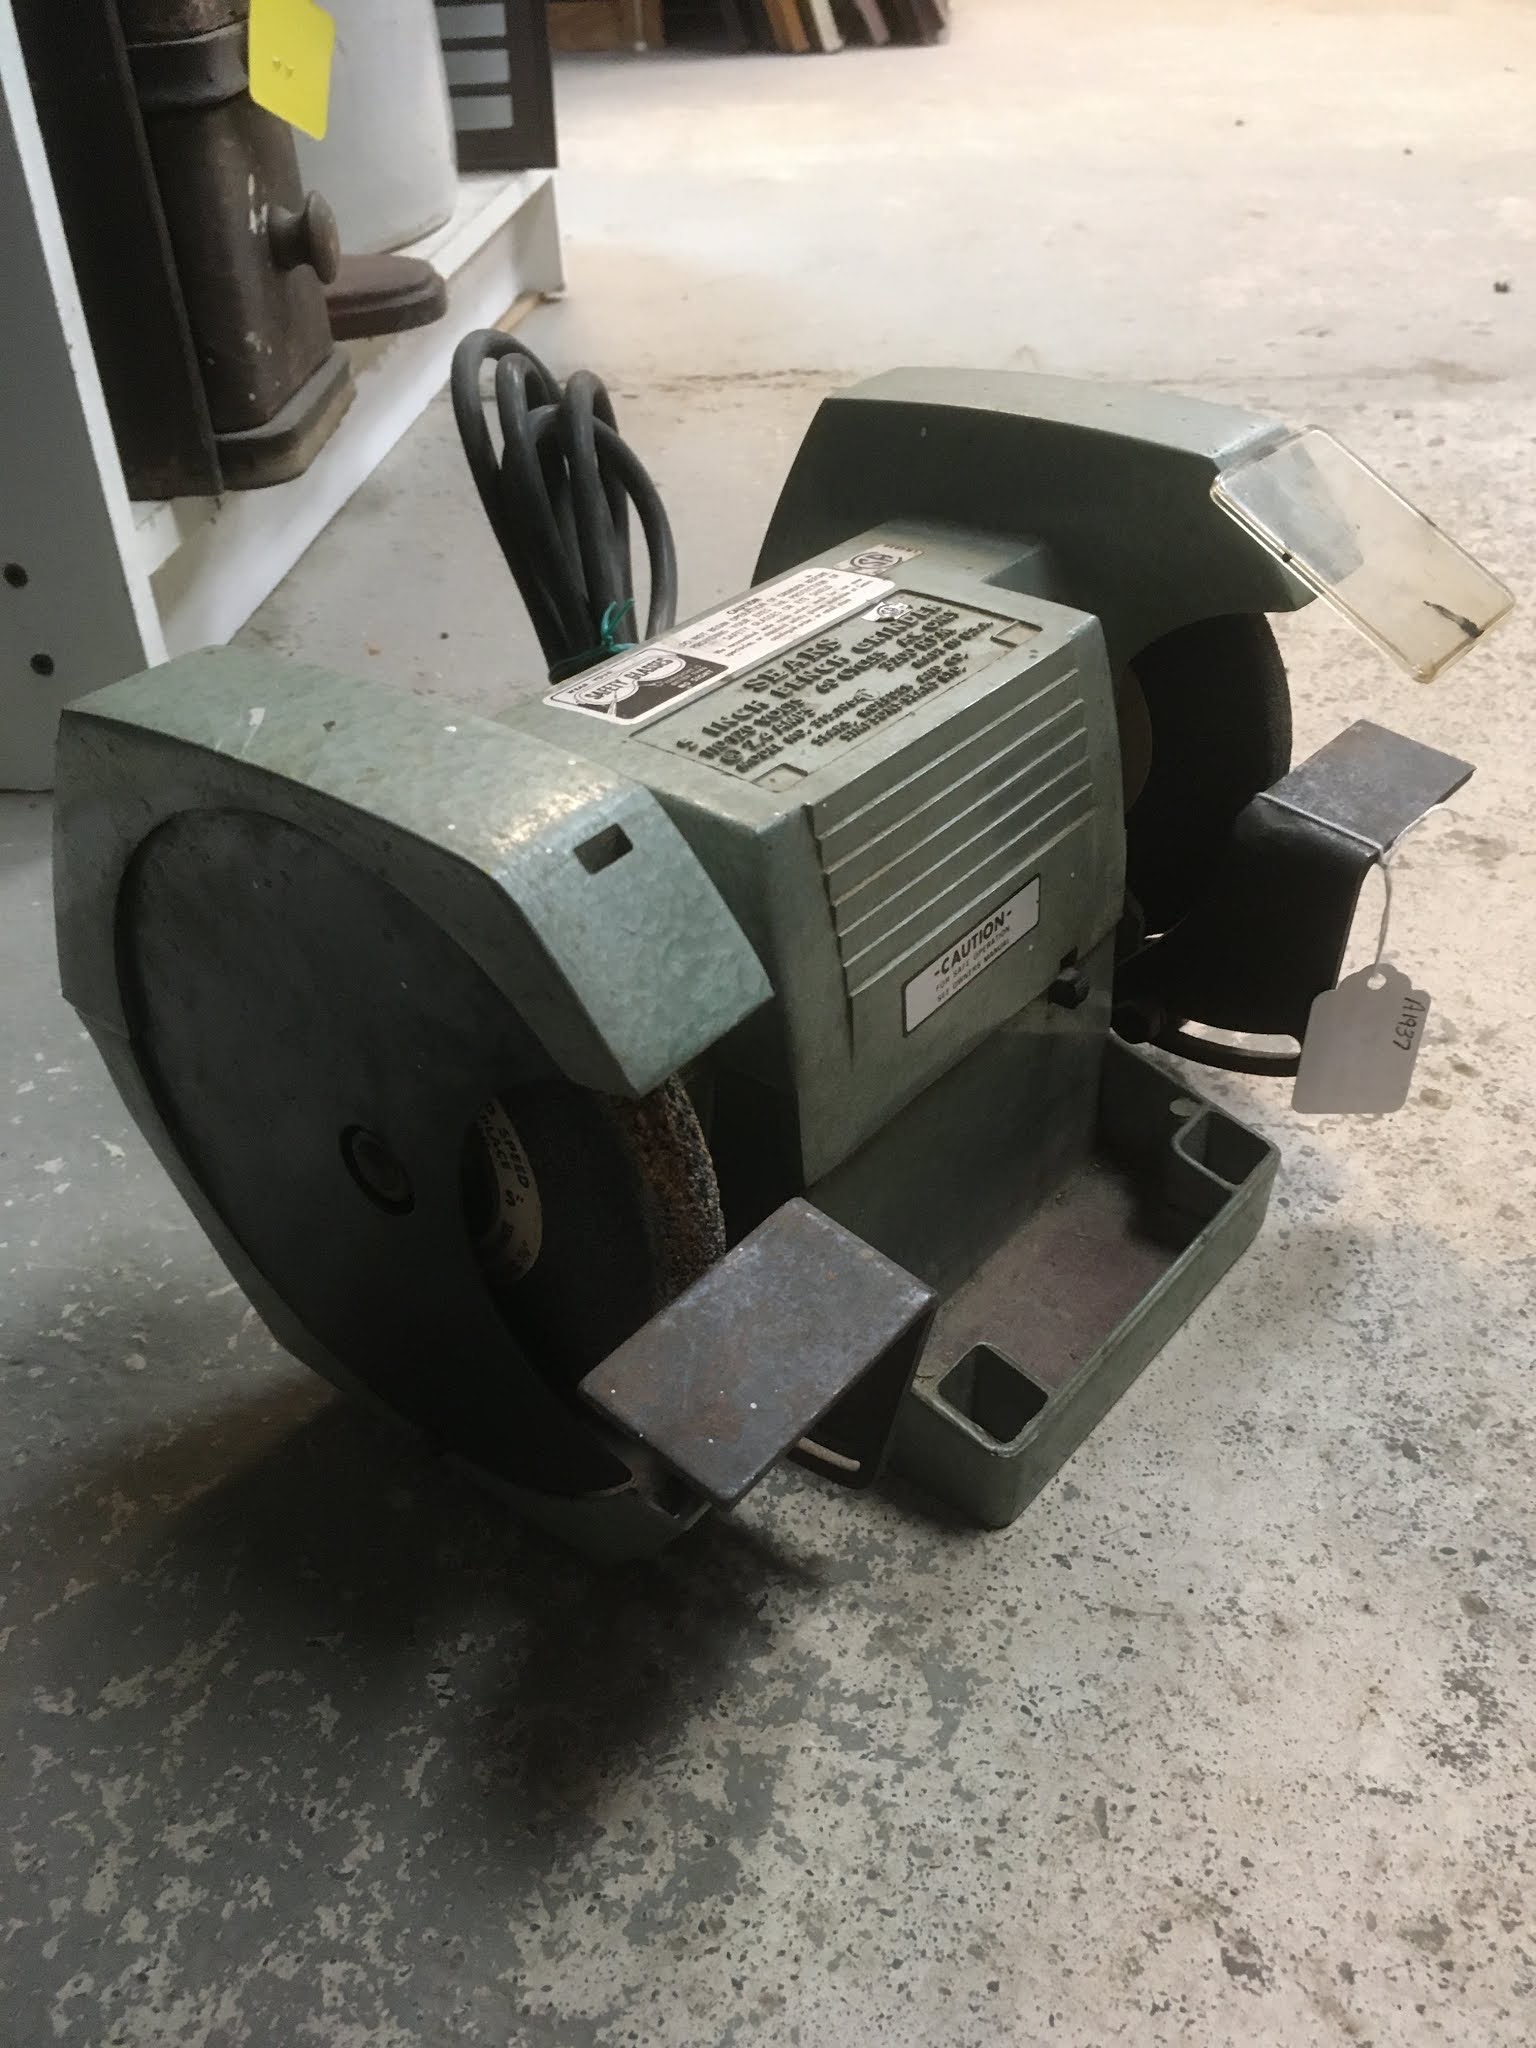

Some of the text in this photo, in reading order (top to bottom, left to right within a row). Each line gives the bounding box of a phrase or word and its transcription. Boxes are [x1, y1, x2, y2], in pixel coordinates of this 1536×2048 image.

[584, 679, 628, 700] SAFETY
[624, 657, 673, 680] GLASSES
[702, 700, 770, 738] INCH
[770, 655, 850, 699] BENCH
[851, 606, 942, 654] GRINDER
[742, 639, 841, 693] SEARS
[815, 678, 839, 695] 60
[837, 652, 888, 681] CYCLES
[921, 610, 959, 633] ONLY
[936, 925, 1010, 990] FOR SAFE OPERATION
[937, 988, 949, 1002] SEE
[983, 939, 1009, 962] MANUAL
[1392, 997, 1426, 1051] A1937
